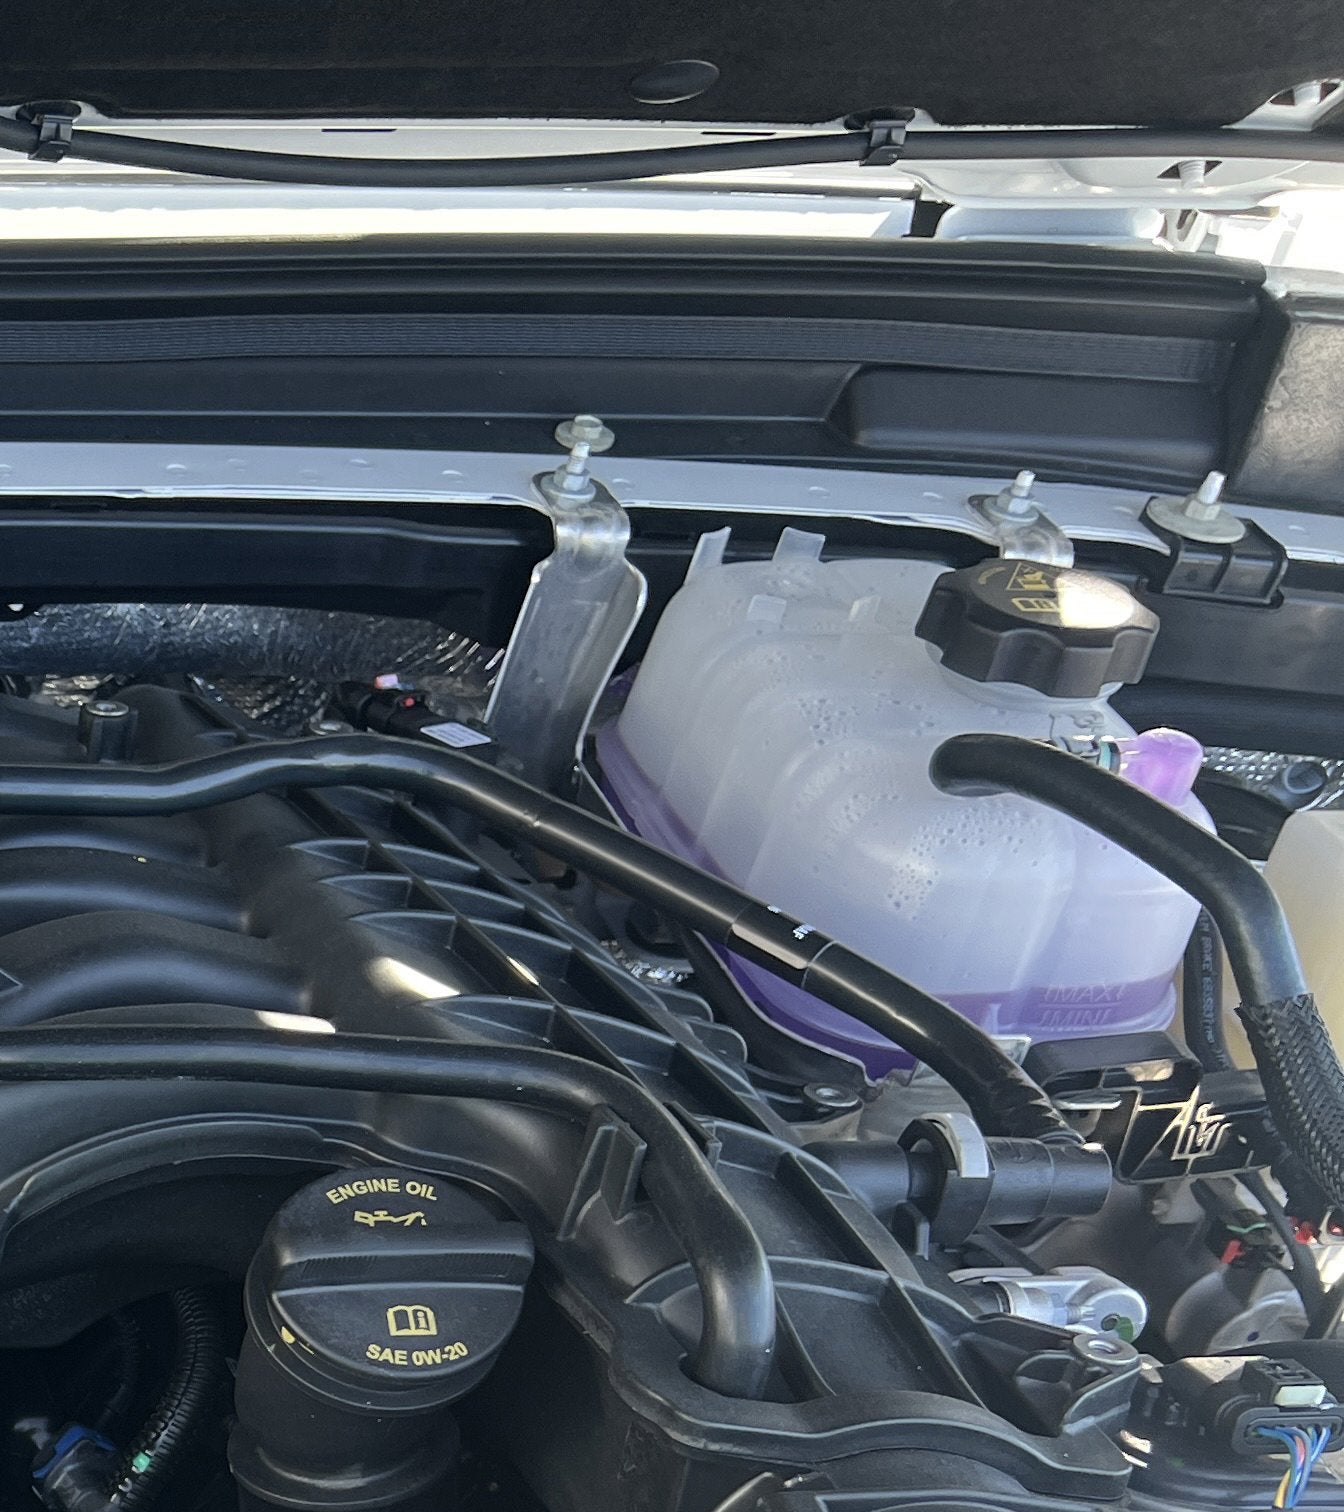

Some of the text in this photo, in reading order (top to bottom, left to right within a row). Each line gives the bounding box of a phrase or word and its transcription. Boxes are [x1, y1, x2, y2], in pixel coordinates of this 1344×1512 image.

[326, 1178, 438, 1205] ENGINE OIL
[366, 1341, 469, 1366] SAE 0W-20
